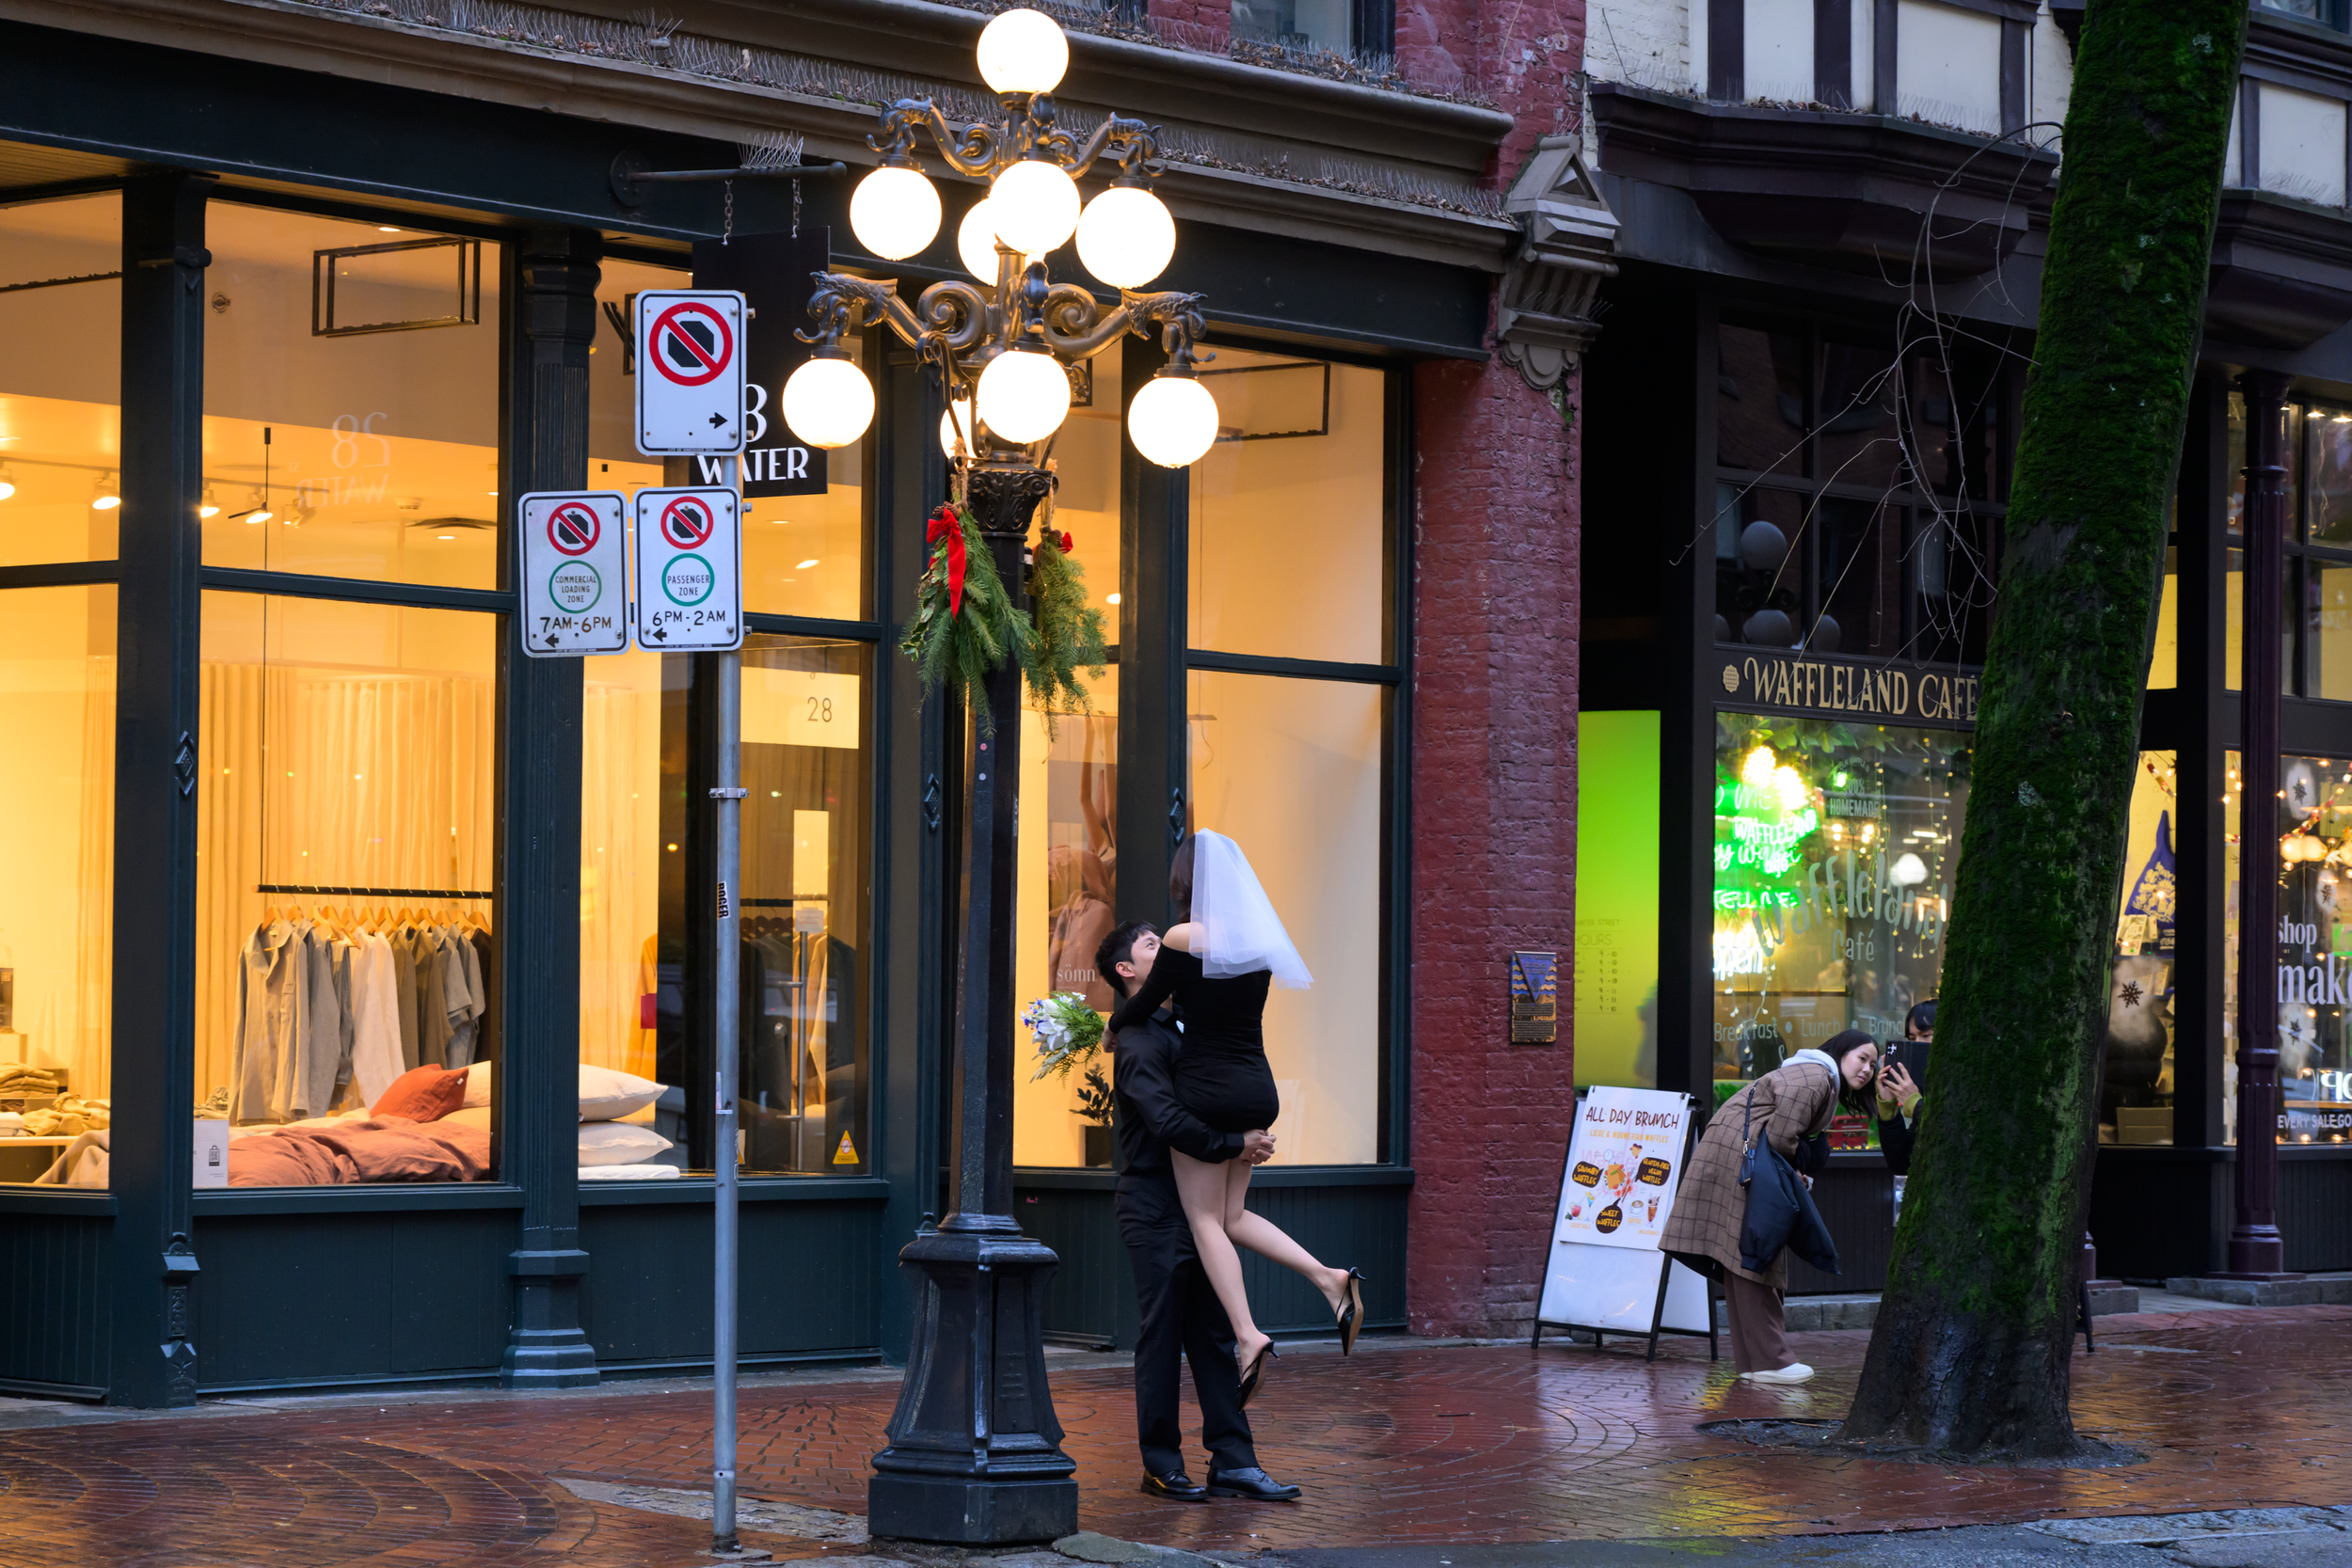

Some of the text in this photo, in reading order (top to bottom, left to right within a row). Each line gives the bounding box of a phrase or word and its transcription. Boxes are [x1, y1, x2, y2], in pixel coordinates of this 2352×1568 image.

[555, 576, 596, 584] COMMERCIAL
[667, 575, 710, 584] PASSENGER
[562, 585, 590, 594] LOADING
[678, 587, 698, 596] ZONE
[1744, 657, 1909, 715] WAFFLELAND
[806, 696, 833, 722] 28
[1829, 798, 1880, 818] HOMEMADE
[717, 882, 729, 919] ROGER
[1832, 928, 1875, 962] Café
[1056, 964, 1096, 983] sömn
[2278, 951, 2352, 1006] mak
[1713, 1019, 1779, 1042] Breakfast
[1801, 1017, 1841, 1037] Lunch
[1585, 1106, 1680, 1130] ALL DAY BRUNCH
[2277, 1114, 2310, 1129] EVERY
[2312, 1114, 2337, 1129] SALE
[1612, 1131, 1644, 1141] NORWEGIAN
[1645, 1133, 1669, 1144] WAFFLES
[1573, 1173, 1597, 1185] WAFFLES
[1600, 1209, 1619, 1218] SWEET
[1597, 1218, 1621, 1228] WAFFLES
